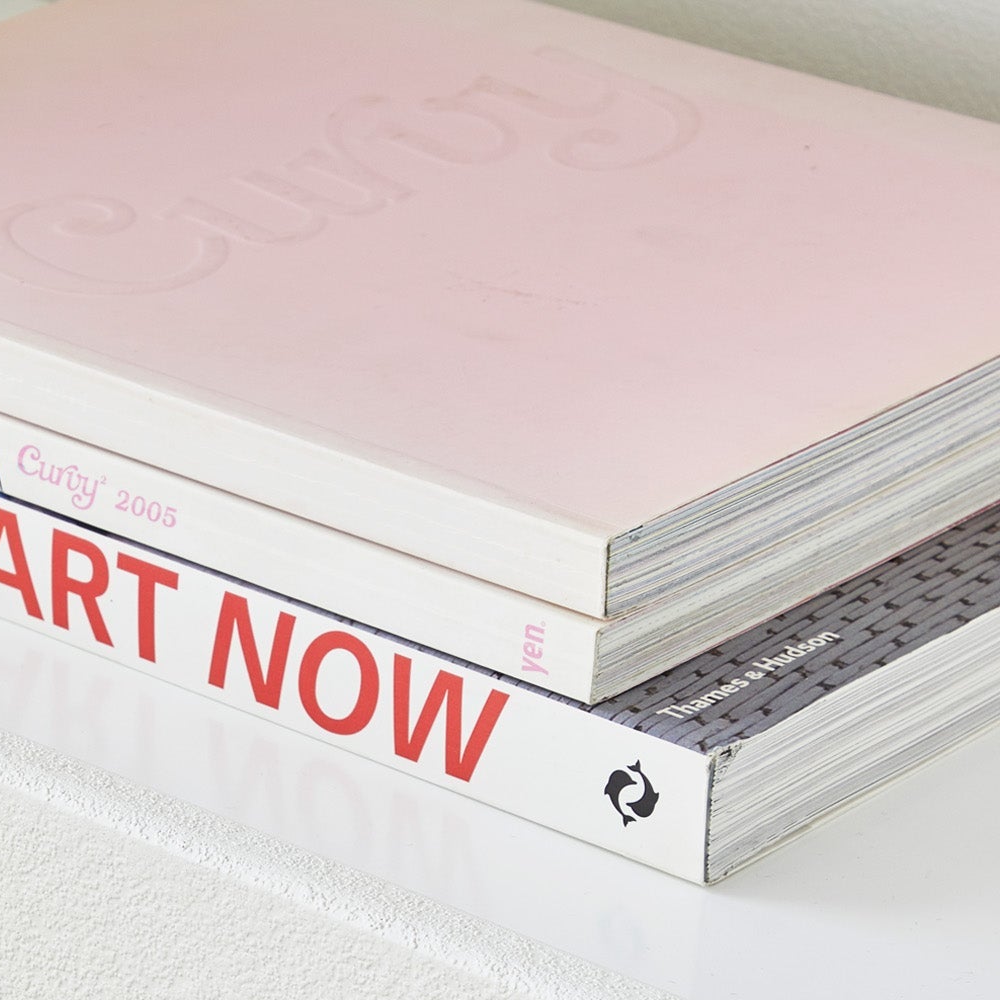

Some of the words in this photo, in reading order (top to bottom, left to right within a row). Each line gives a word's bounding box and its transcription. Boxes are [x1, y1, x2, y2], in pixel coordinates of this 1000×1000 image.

[114, 489, 178, 529] 2005
[752, 630, 841, 672] Hudson
[208, 591, 510, 782] NOW
[749, 670, 765, 681] &
[655, 677, 750, 720] Thames
